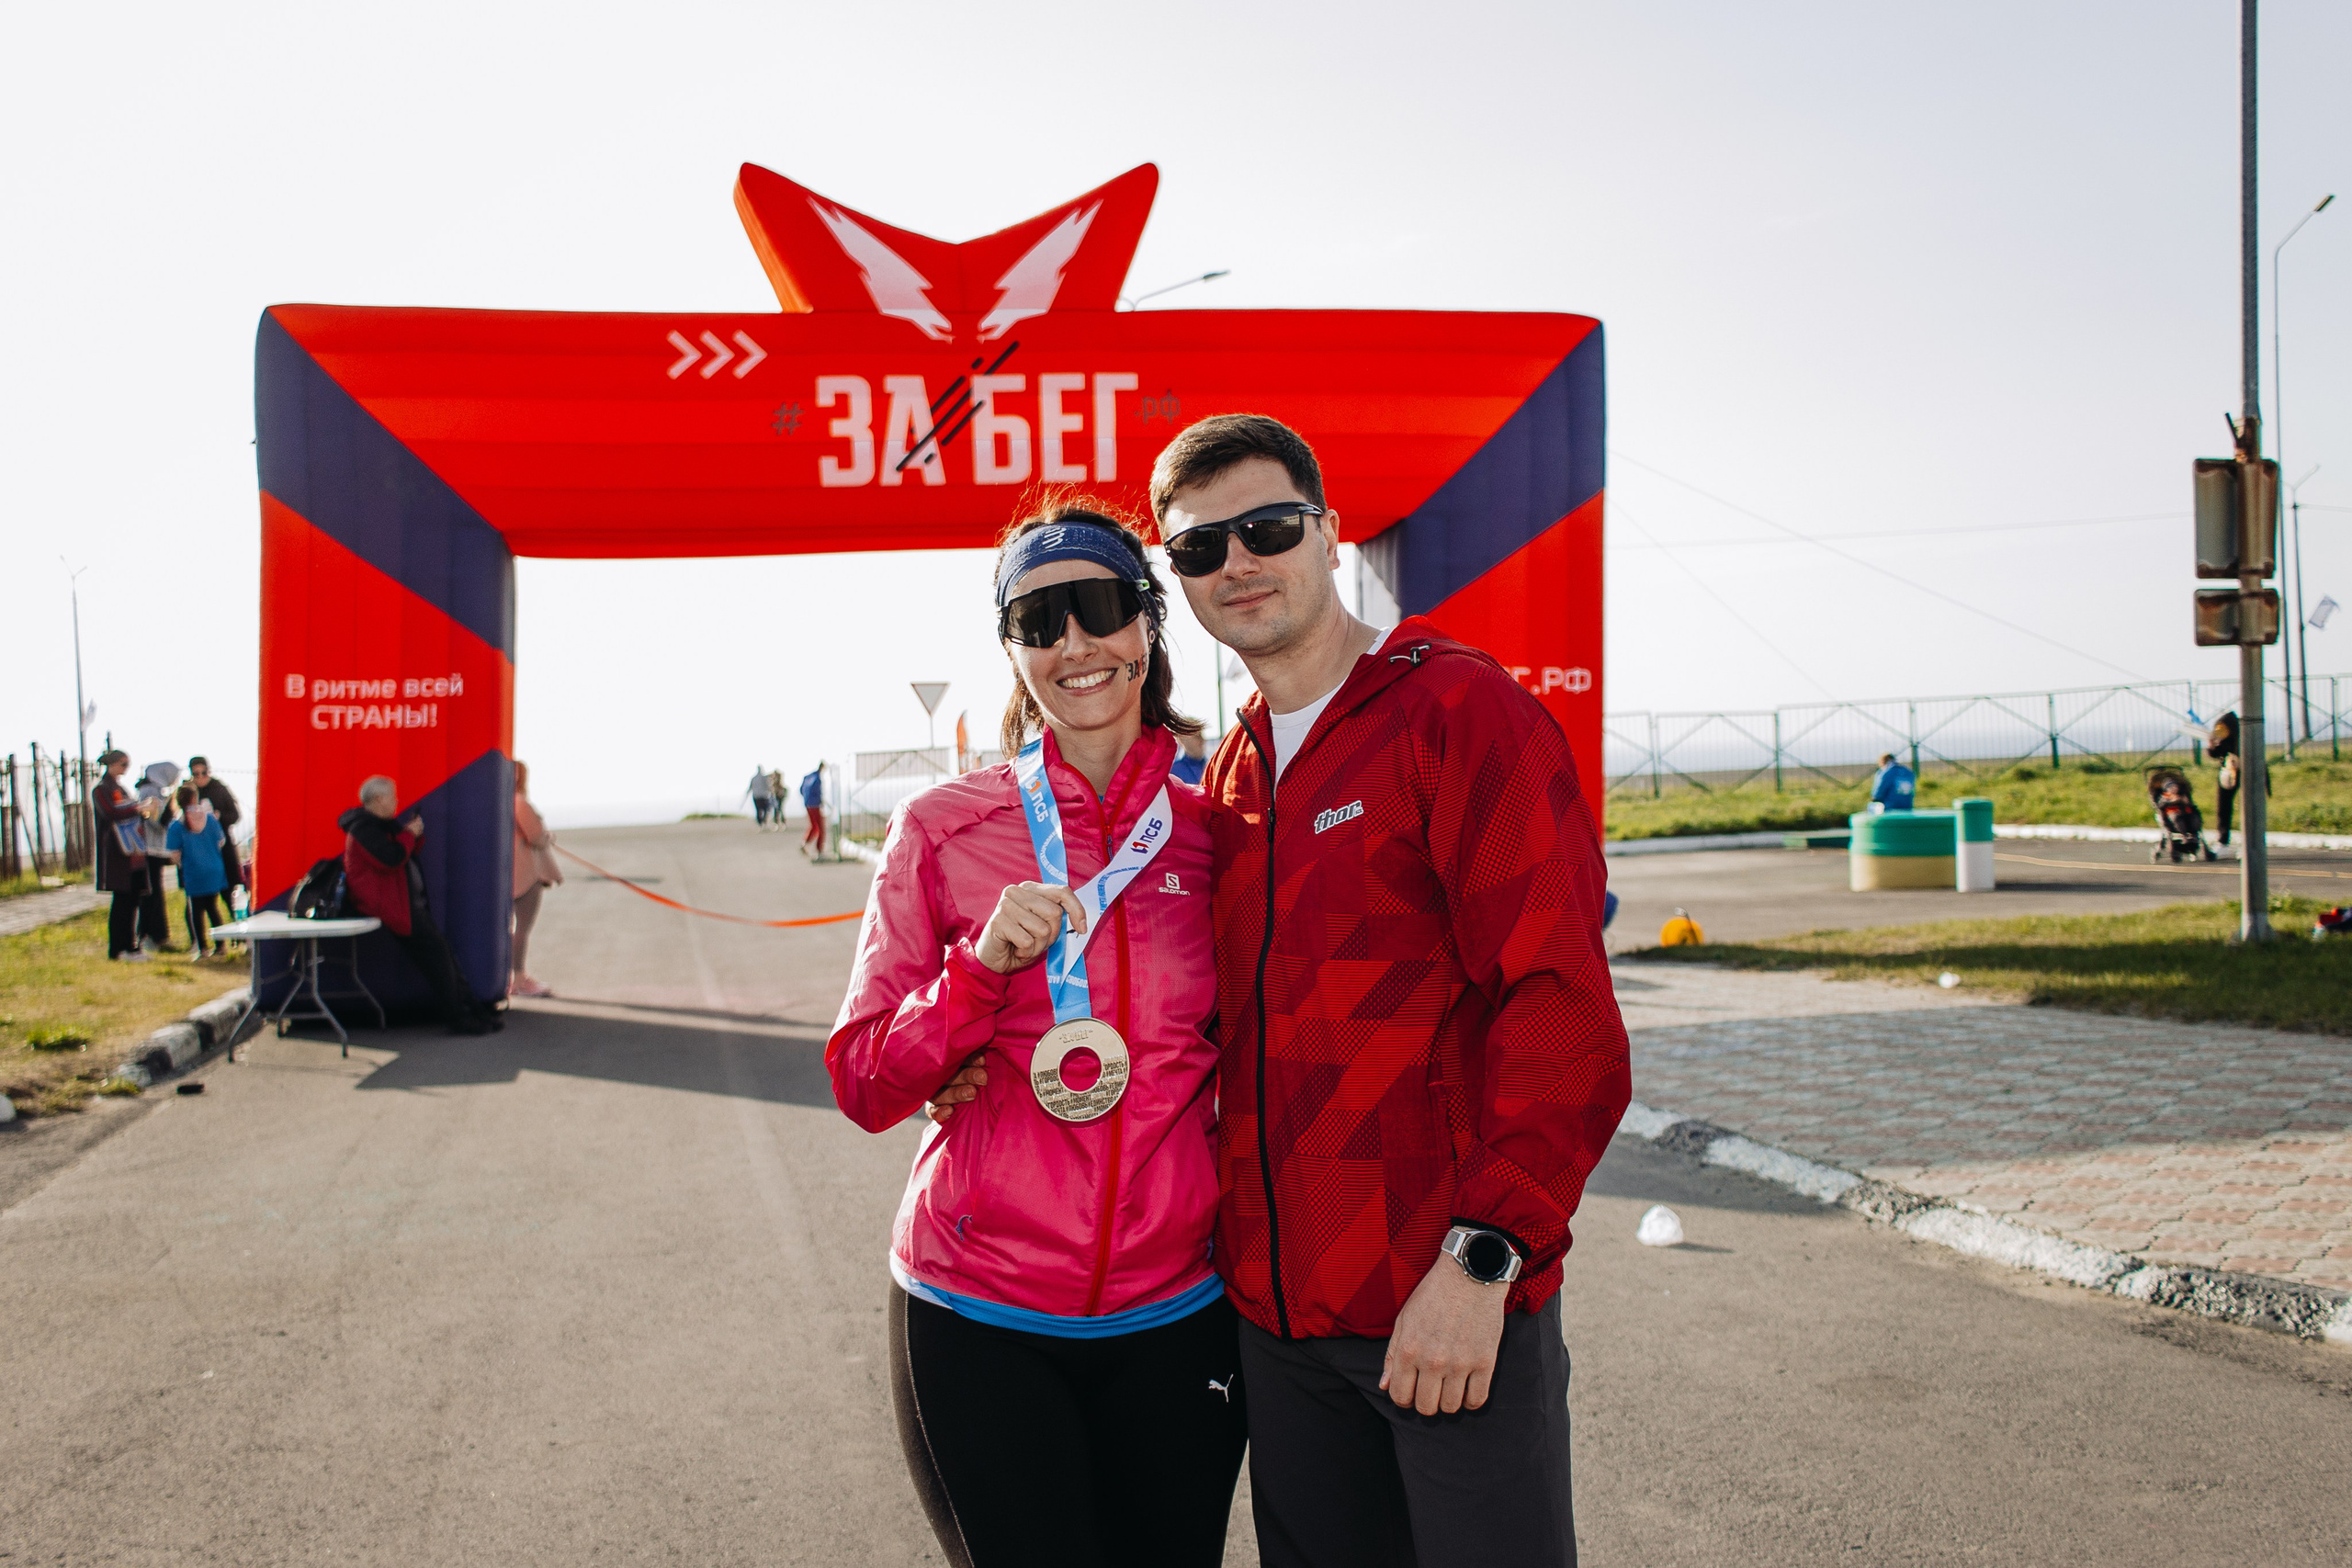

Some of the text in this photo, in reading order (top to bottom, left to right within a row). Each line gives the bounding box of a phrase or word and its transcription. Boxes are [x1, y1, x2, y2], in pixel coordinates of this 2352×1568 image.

[285, 672, 463, 702] В ритме всей
[311, 703, 437, 729] СТРАНЫ!
[1032, 792, 1049, 823] ПСБ
[1139, 818, 1162, 843] ПСБ
